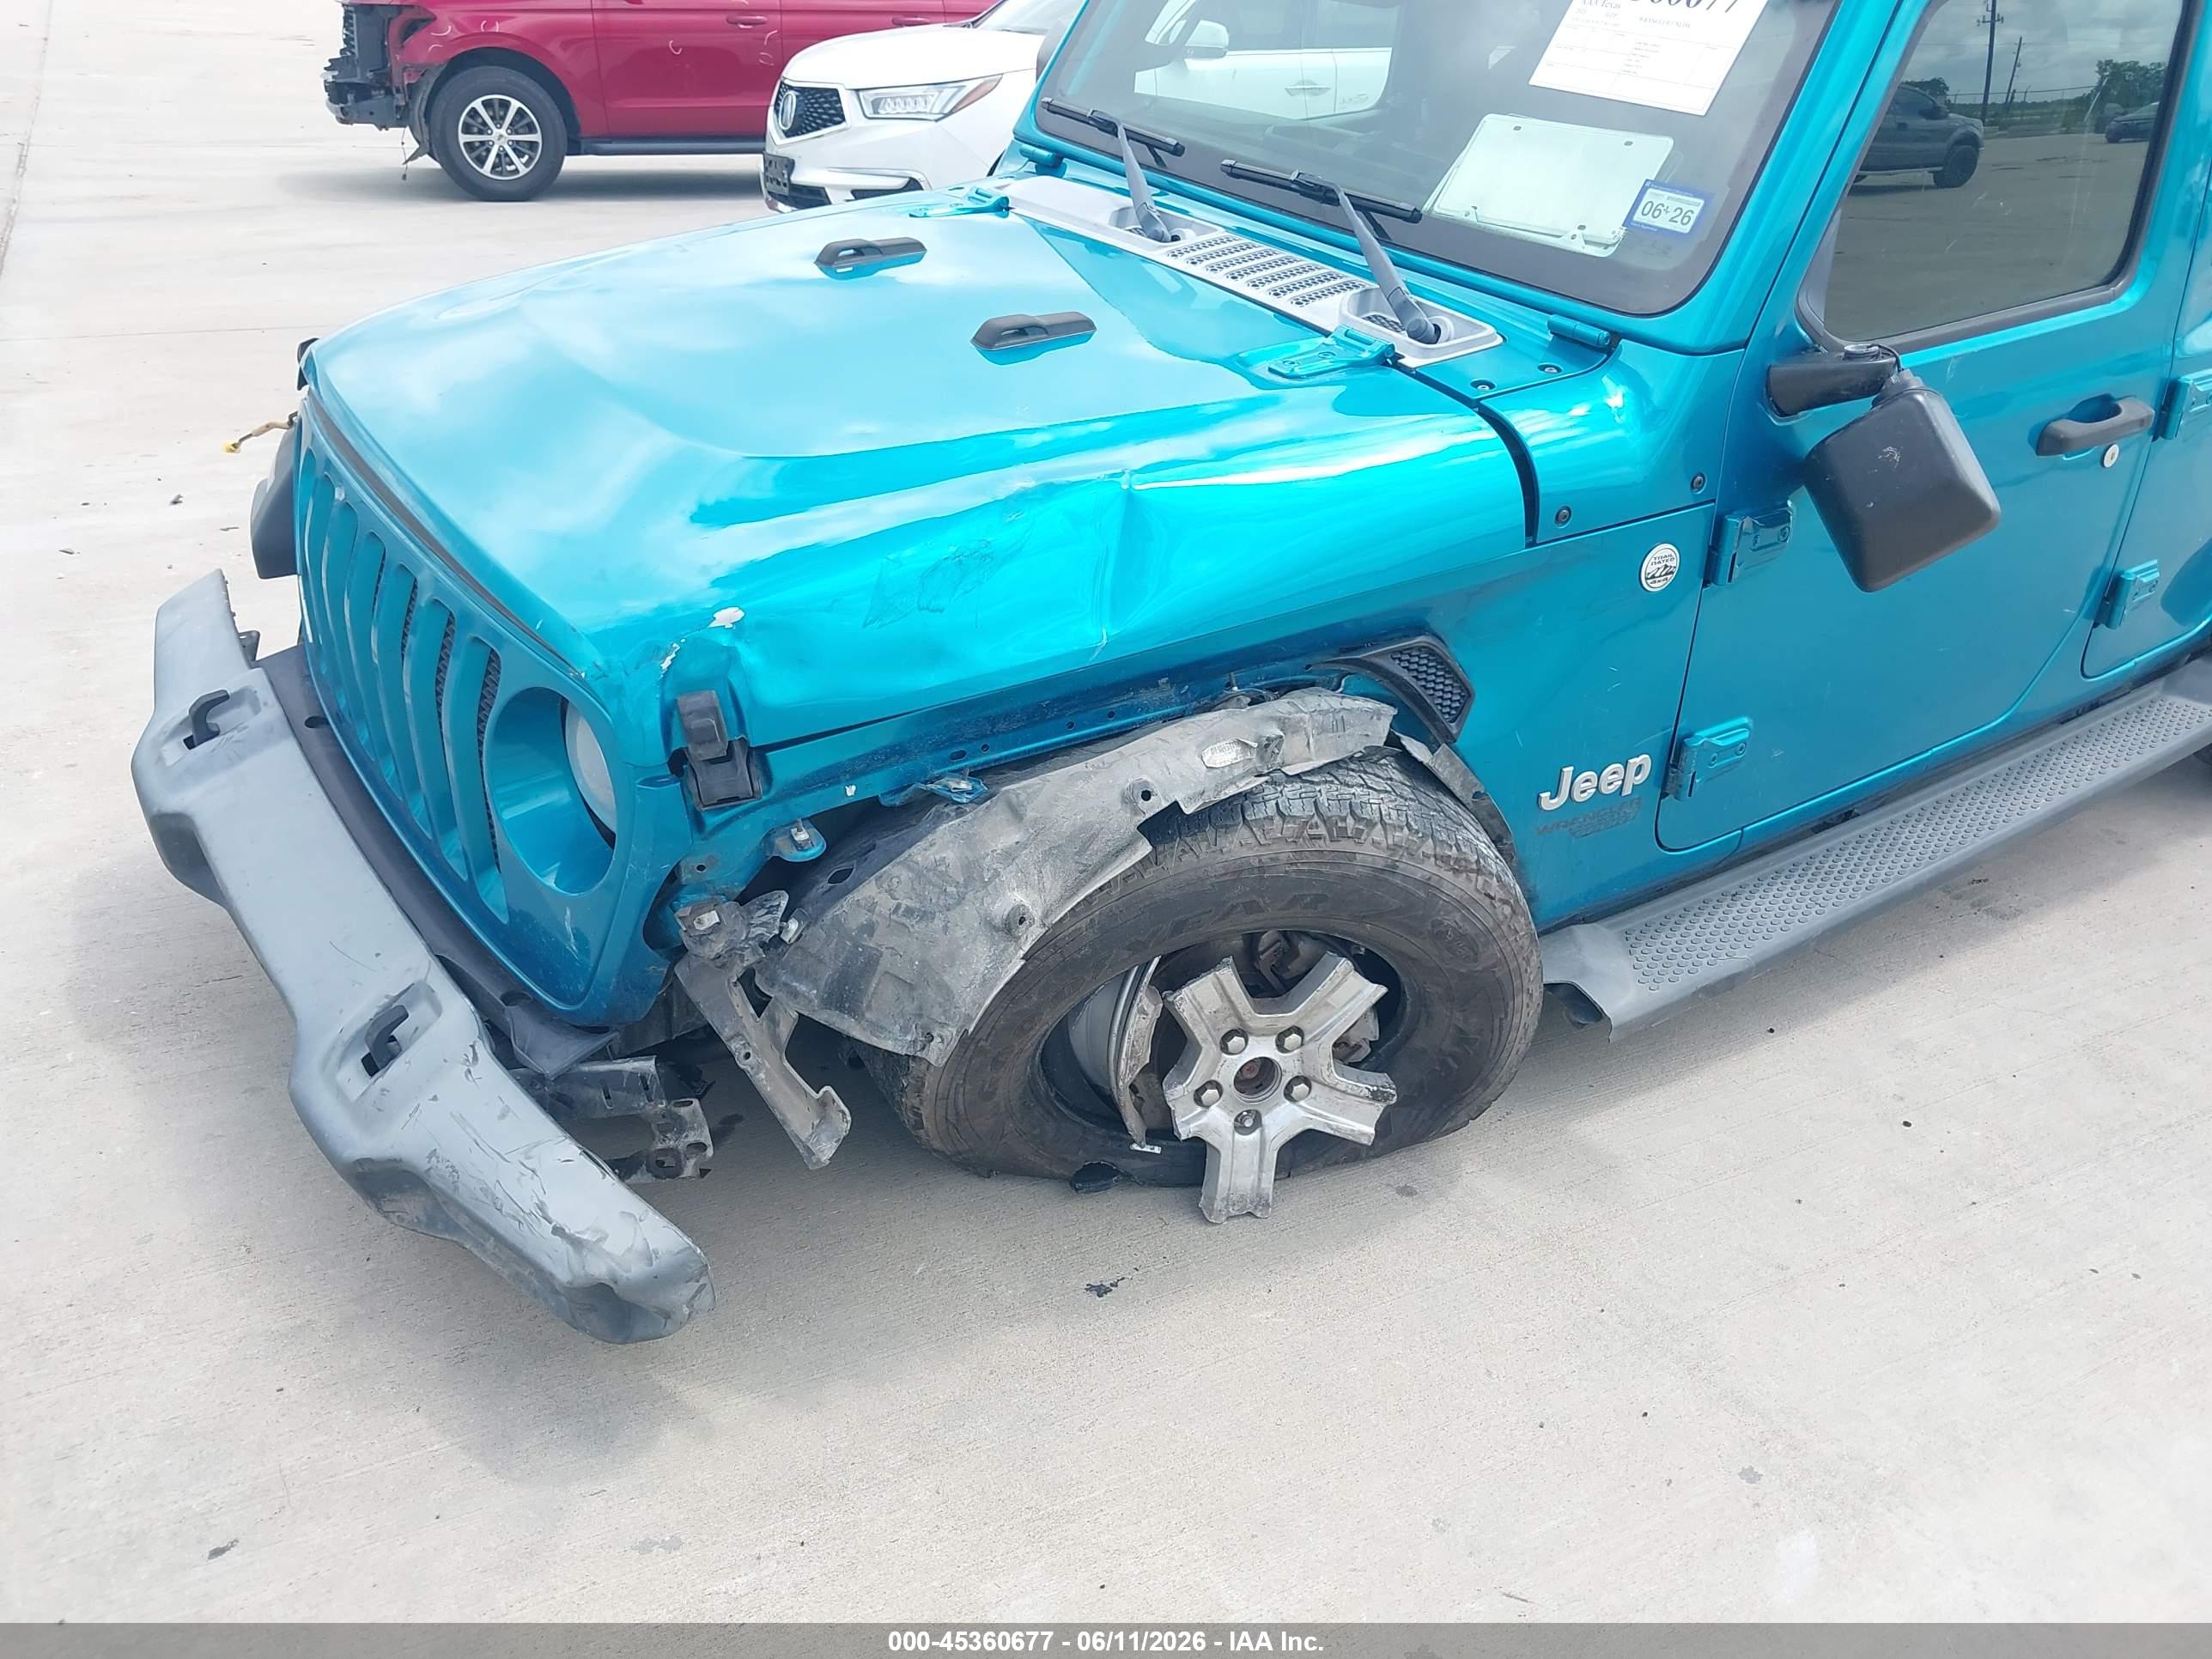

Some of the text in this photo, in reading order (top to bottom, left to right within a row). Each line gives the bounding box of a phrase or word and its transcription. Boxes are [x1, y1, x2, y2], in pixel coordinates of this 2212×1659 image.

[1641, 200, 1694, 226] 06 26
[1650, 557, 1675, 566] RATED
[1537, 754, 1652, 811] Jeep
